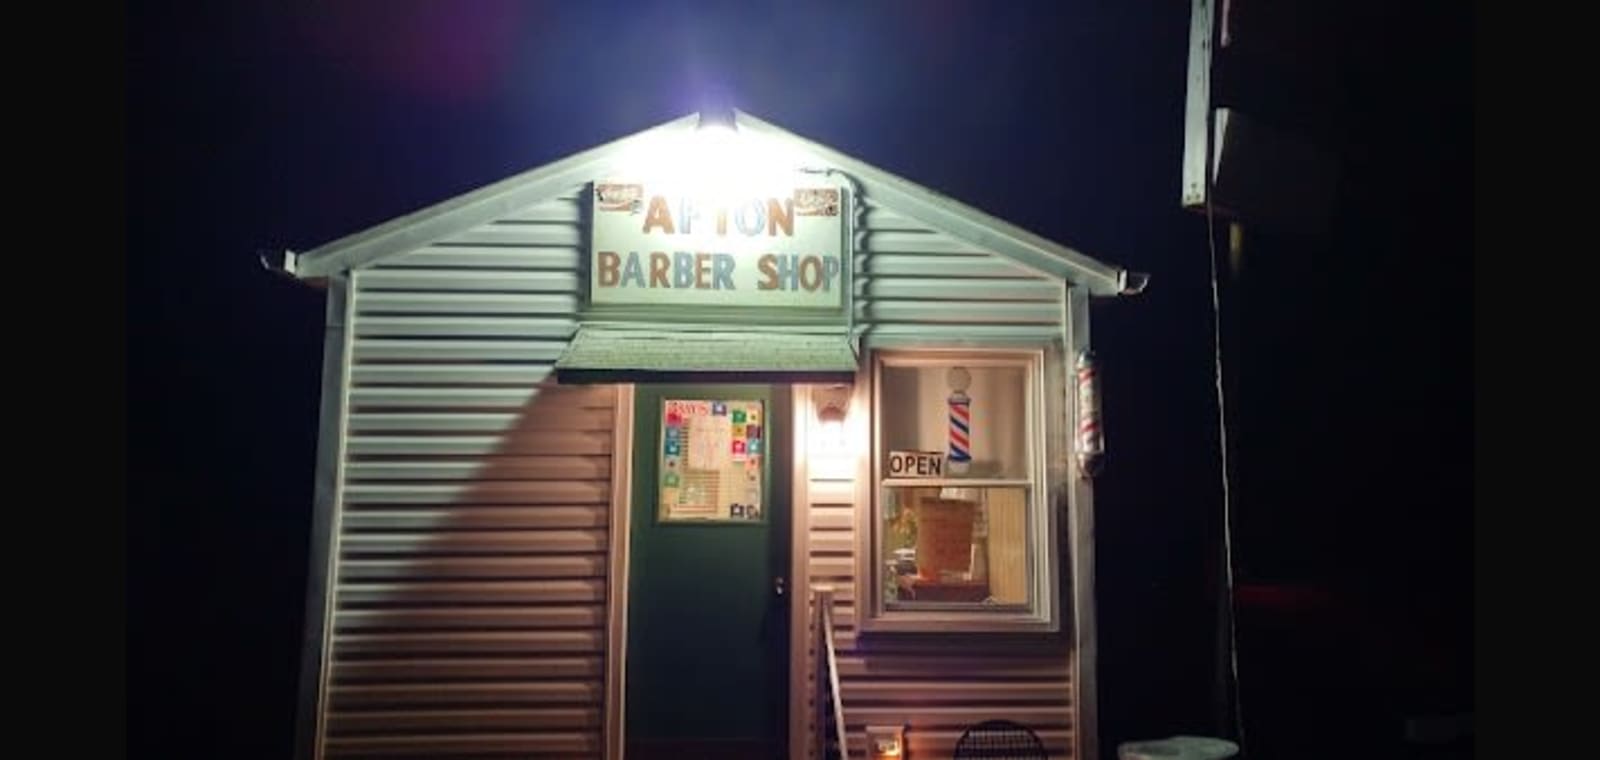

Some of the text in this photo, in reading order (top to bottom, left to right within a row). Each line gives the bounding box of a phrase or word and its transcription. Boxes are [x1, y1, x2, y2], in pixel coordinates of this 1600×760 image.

[597, 251, 839, 292] BARBER SHOP
[890, 455, 941, 476] OPEN
